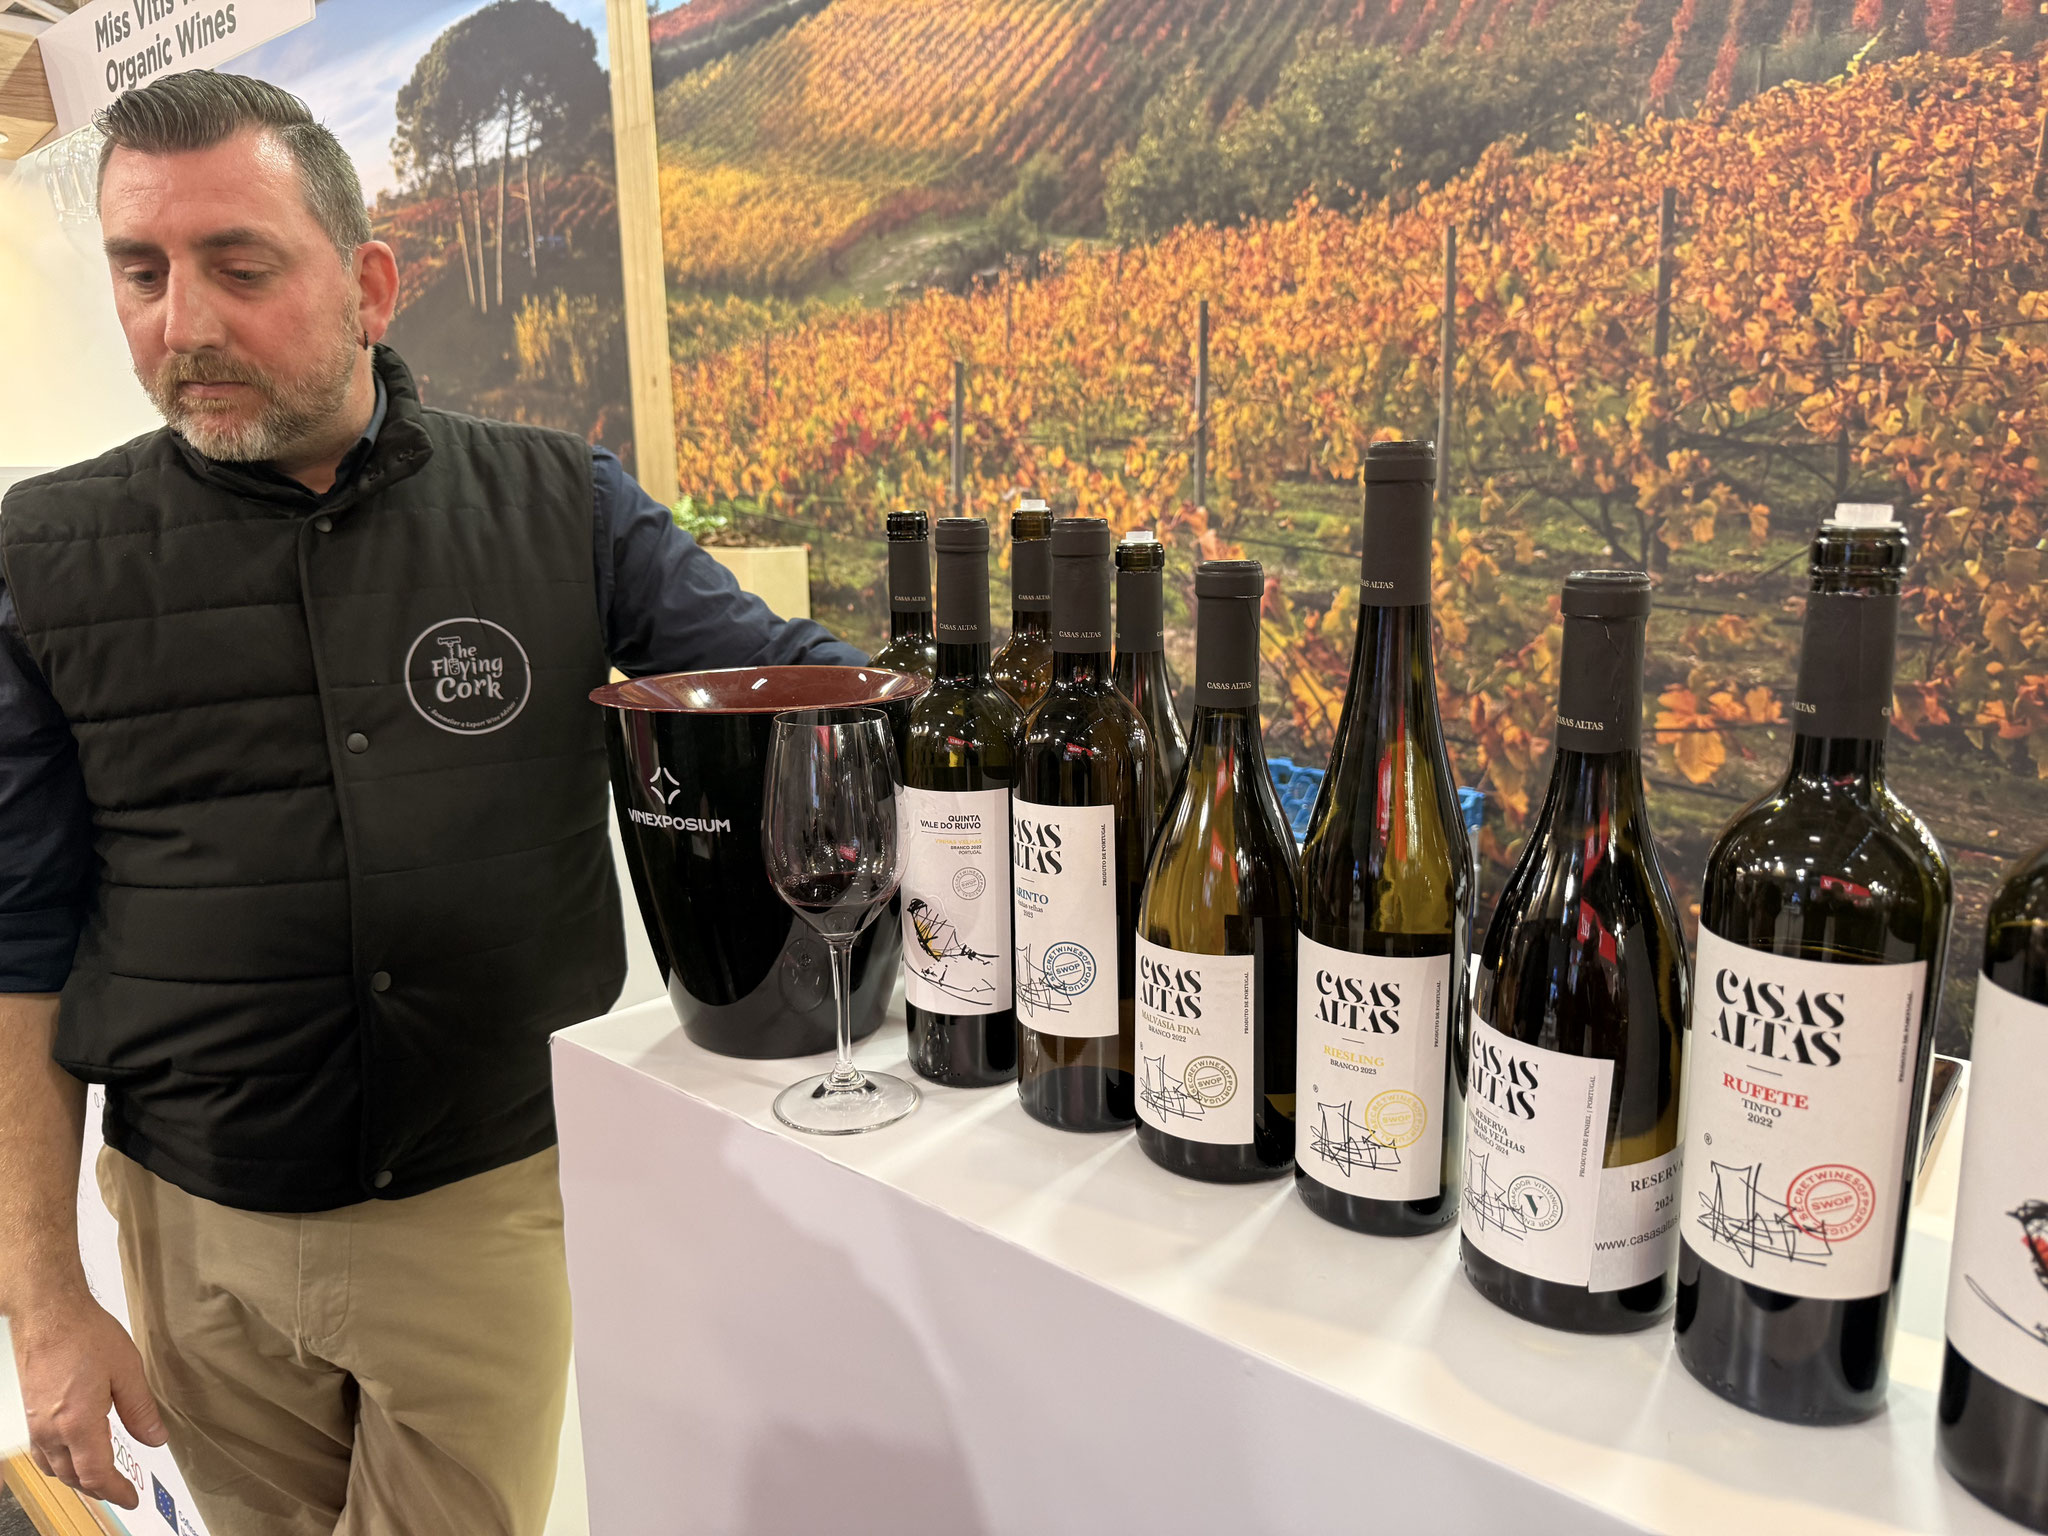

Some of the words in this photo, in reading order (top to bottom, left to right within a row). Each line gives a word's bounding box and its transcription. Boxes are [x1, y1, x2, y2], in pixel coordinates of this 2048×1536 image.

[95, 11, 131, 53] Miss
[133, 0, 174, 30] Vitis
[106, 33, 173, 93] Organic
[175, 3, 237, 58] Wines
[1370, 581, 1394, 589] ALTAS
[1059, 630, 1079, 639] CASAS
[1080, 631, 1102, 639] ALTAS
[436, 674, 504, 703] Cork
[1206, 681, 1230, 690] CASAS
[1230, 682, 1252, 690] ALTAS
[1575, 720, 1604, 731] ALTAS
[628, 808, 731, 833] VINEXPOSIUM
[920, 820, 939, 829] VALE
[1014, 842, 1062, 875] LTAS
[1056, 962, 1081, 975] SWOP
[1140, 955, 1202, 994] CASAS
[1140, 981, 1202, 1019] ALTAS
[1315, 970, 1401, 1008] CASAS
[1715, 967, 1845, 1029] CASAS
[1141, 1009, 1175, 1033] MALVASIA
[1177, 1023, 1202, 1037] FINA
[1314, 996, 1401, 1034] ALTAS
[1148, 1024, 1171, 1039] BRANCO
[1171, 1033, 1187, 1043] 2022
[1711, 1006, 1842, 1067] ALTAS
[1323, 1044, 1385, 1068] RIESLING
[1330, 1058, 1360, 1072] BRANCO
[1360, 1066, 1377, 1076] 2023
[1472, 1030, 1539, 1090] CASAS
[1198, 1077, 1223, 1088] SWOP
[1469, 1061, 1536, 1120] ALTAS
[1586, 1075, 1597, 1109] PORTUGAL
[1722, 1072, 1809, 1110] RUFETE
[1475, 1107, 1508, 1136] RESERVA
[1741, 1097, 1783, 1119] TINTO
[1747, 1112, 1773, 1129] 2022
[1583, 1114, 1592, 1137] PINHEL
[1489, 1128, 1526, 1154] VELHAS
[1582, 1138, 1589, 1147] DE
[1578, 1147, 1588, 1178] PRODUTO
[1654, 1193, 1674, 1212] 2024
[1811, 1194, 1854, 1211] SWOP
[113, 1436, 145, 1491] 2030
